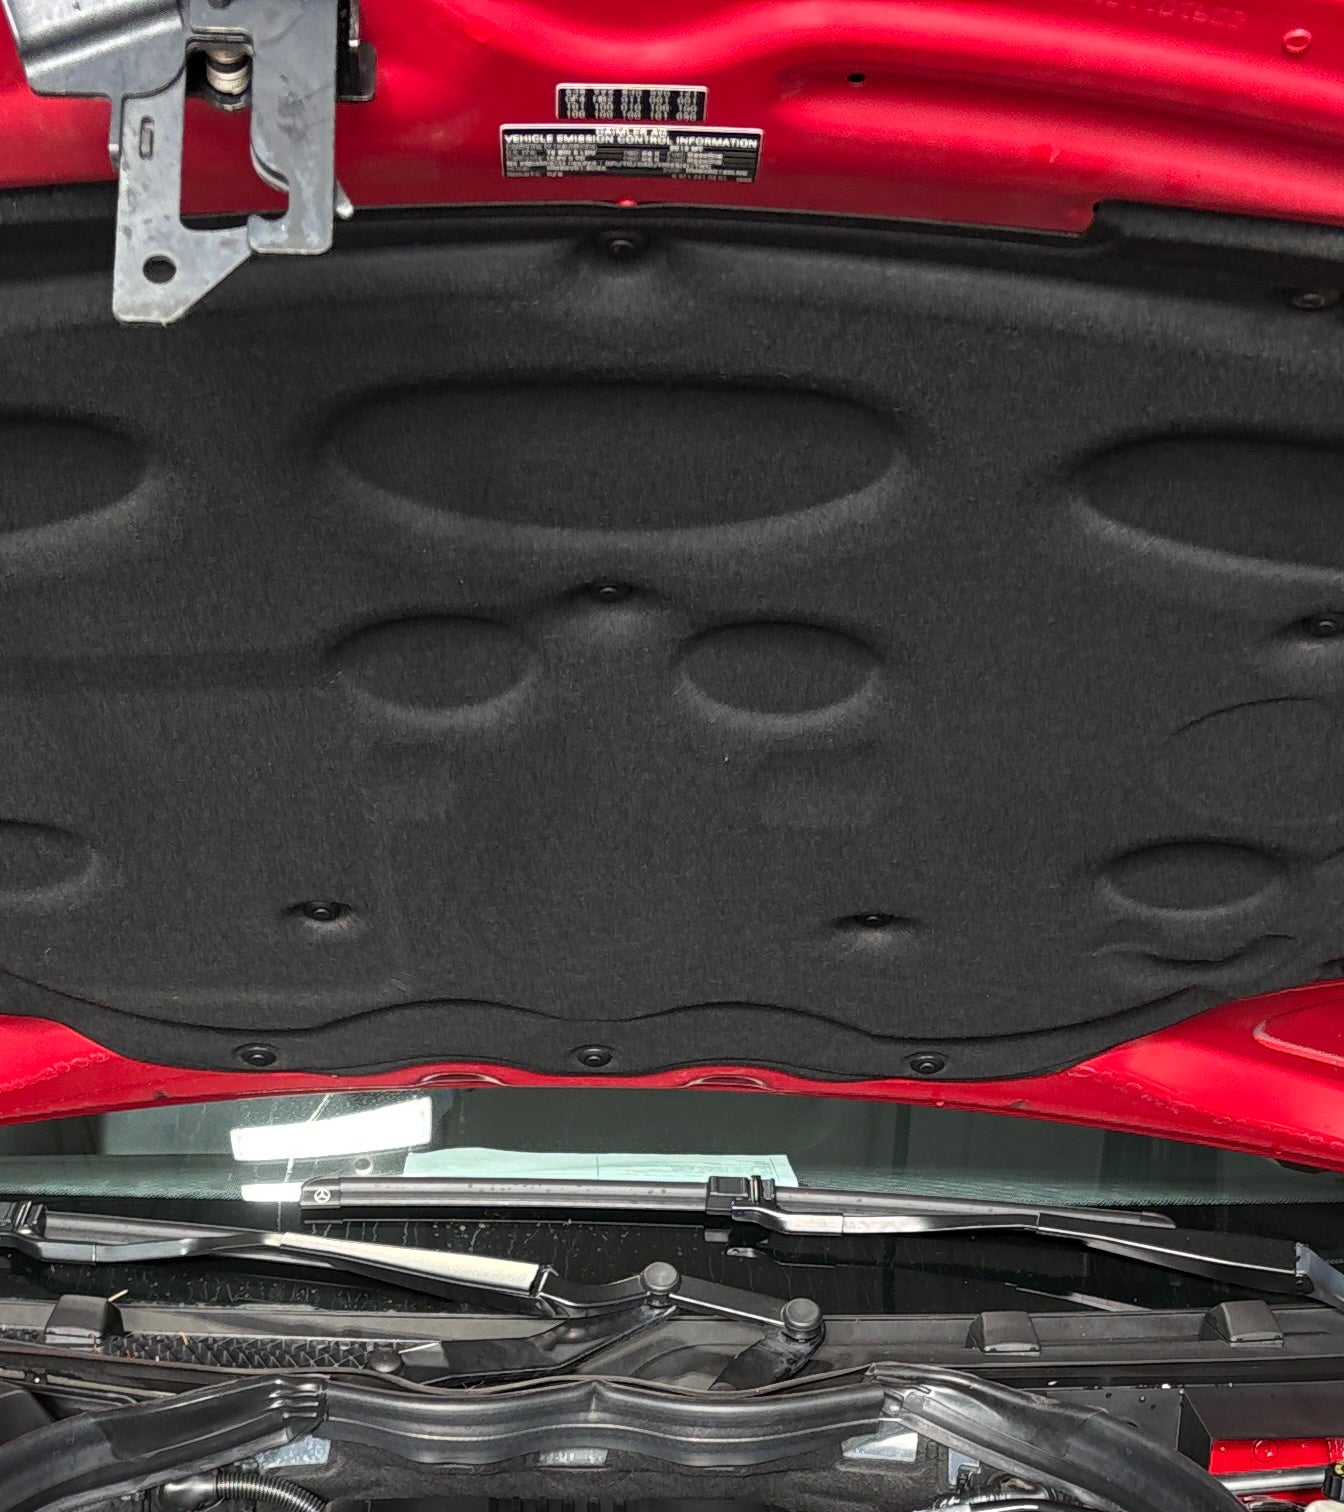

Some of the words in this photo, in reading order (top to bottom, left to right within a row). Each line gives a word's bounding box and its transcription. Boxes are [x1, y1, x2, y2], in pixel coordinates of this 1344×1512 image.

[504, 134, 554, 144] VEHICLE
[556, 134, 614, 144] EMISSION
[617, 135, 672, 145] CONTROL
[676, 136, 757, 148] INFORMATION
